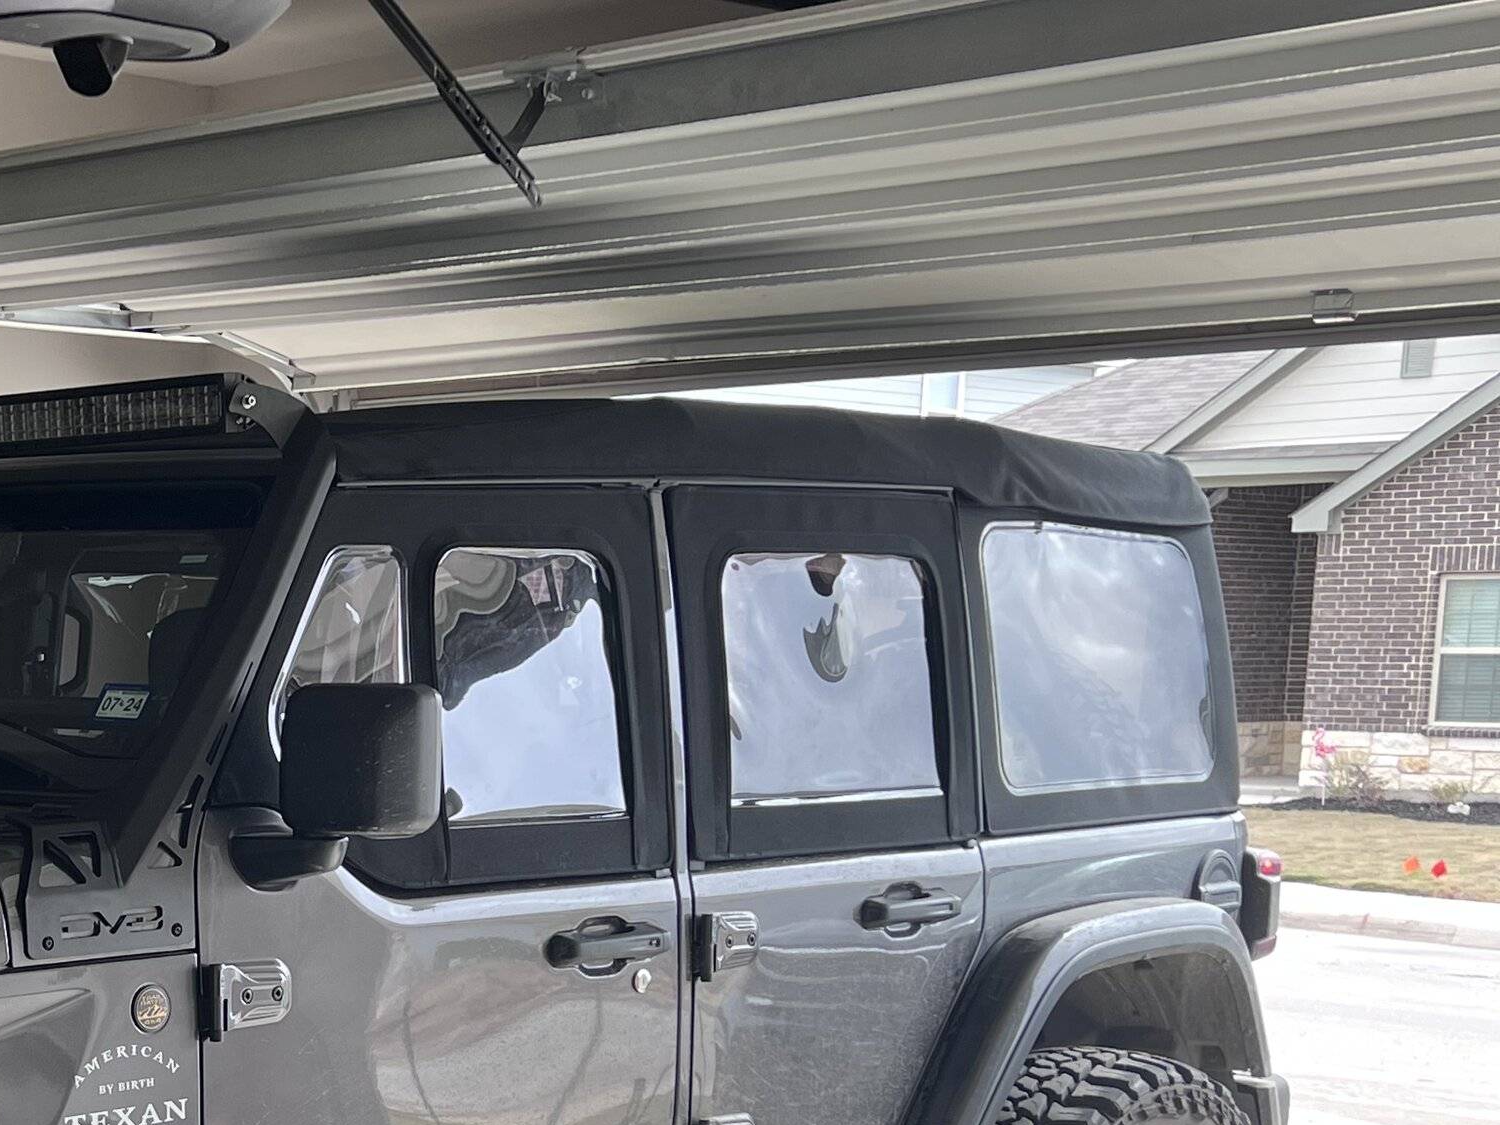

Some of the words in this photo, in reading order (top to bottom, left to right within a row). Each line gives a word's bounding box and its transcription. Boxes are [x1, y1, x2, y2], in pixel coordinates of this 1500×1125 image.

[73, 1044, 180, 1089] AMERICAN
[99, 1084, 114, 1095] BY
[118, 1077, 156, 1092] BIRTH
